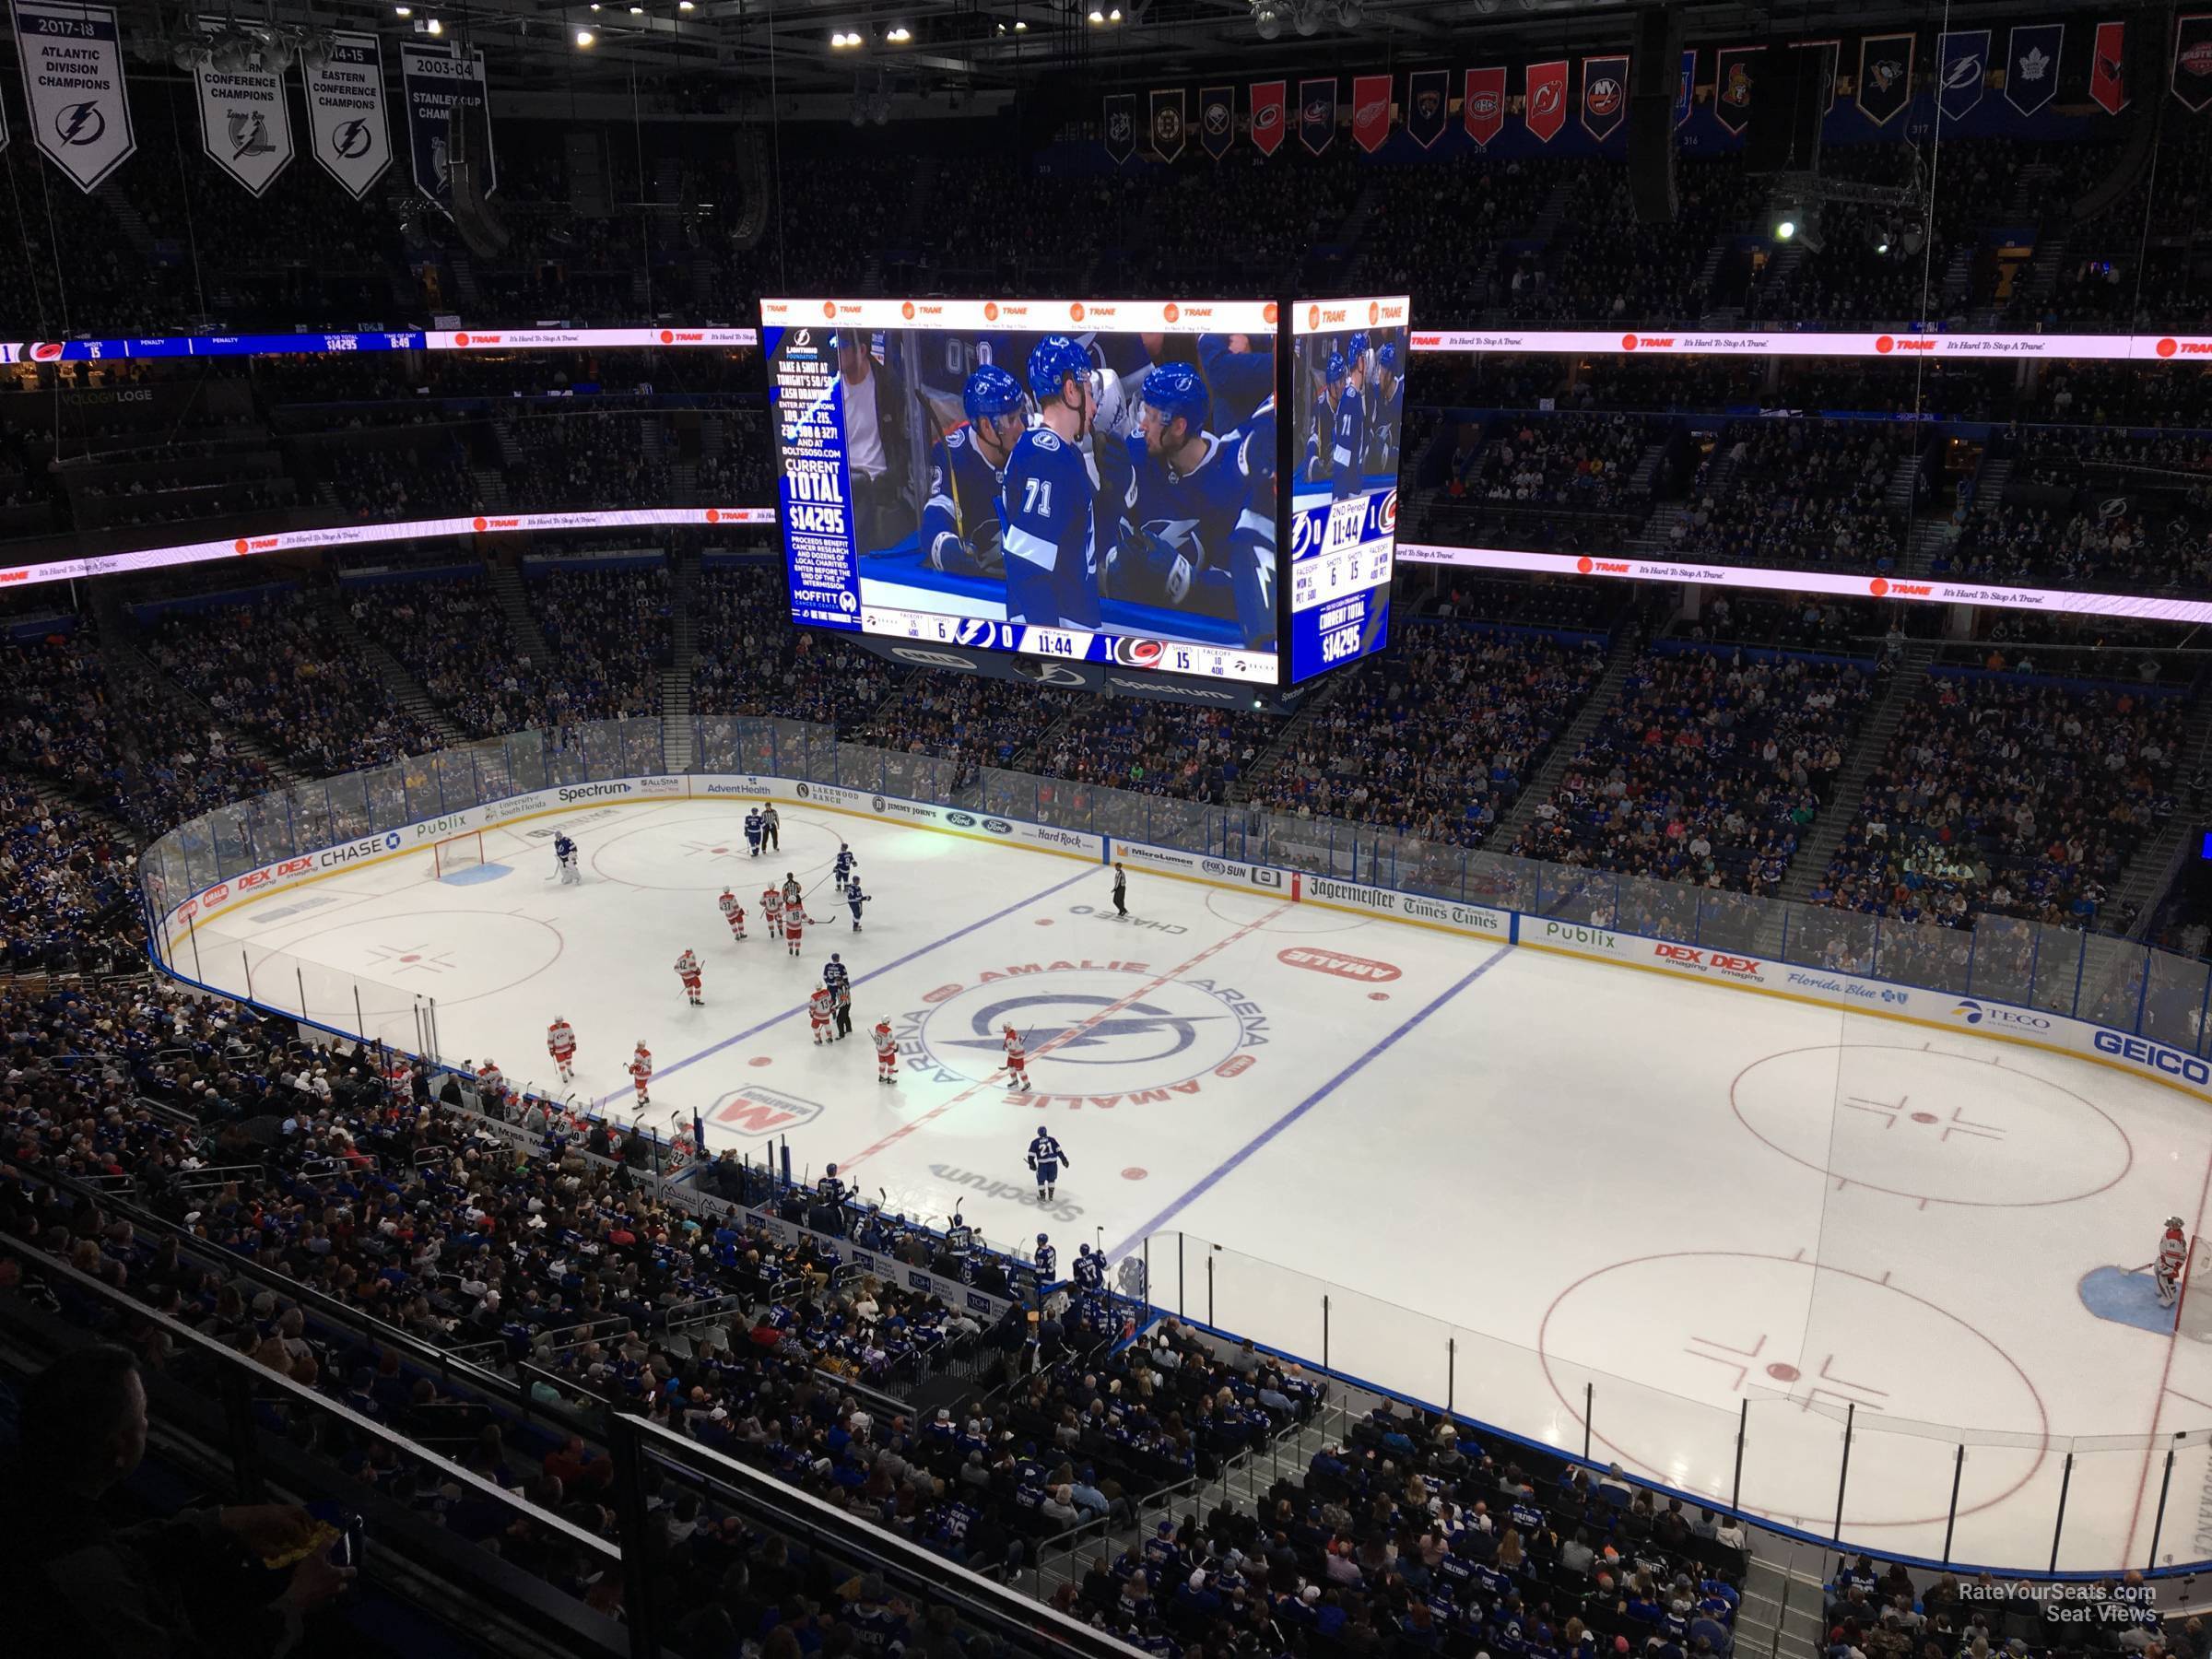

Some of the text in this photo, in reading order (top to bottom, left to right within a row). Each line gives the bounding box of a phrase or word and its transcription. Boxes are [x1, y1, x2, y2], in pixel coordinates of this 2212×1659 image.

[41, 47, 100, 60] ATLANTIC
[46, 62, 98, 75] DIVISION
[418, 60, 472, 76] 2003-04
[38, 76, 110, 90] CHAMPIONS
[205, 73, 276, 88] CONFERENCE
[322, 71, 365, 82] EASTERN
[211, 88, 274, 101] CHAMPIONS
[313, 83, 376, 97] CONFERENCE
[319, 97, 375, 110] CHAMPIONS
[413, 93, 457, 106] STANLEY
[919, 306, 942, 314] TRANE
[1003, 307, 1027, 315] TRANE
[1089, 308, 1116, 316] TRANE
[1184, 308, 1213, 317] TRANE
[1323, 310, 1347, 324] TRANE
[1382, 307, 1403, 318] TRANE
[327, 339, 357, 350] $14295
[392, 338, 409, 347] 8:49
[1411, 336, 1441, 346] TRANE
[1640, 338, 1675, 347] TRANE
[1897, 340, 1937, 350] TRANE
[1947, 341, 1959, 349] It's
[1959, 341, 1981, 350] Hard
[1982, 342, 1991, 350] To
[1993, 341, 2010, 352] Stop
[2011, 342, 2019, 350] A
[91, 347, 100, 358] 15
[779, 361, 828, 373] TAKE A SHOT AT
[777, 374, 810, 386] TONIGHT'S
[782, 447, 841, 458] BOLTS5050.COM
[785, 459, 840, 474] CURRENT
[787, 471, 843, 503] TOTAL
[1023, 478, 1052, 517] 71
[1347, 501, 1366, 514] Period
[489, 519, 519, 528] TRANE
[790, 505, 845, 534] $14295
[1370, 505, 1375, 529] 1
[1313, 519, 1321, 545] 0
[1333, 515, 1359, 546] 11:44
[250, 538, 278, 549] TRANE
[792, 536, 849, 547] PROCEEDS BENEFIT
[792, 543, 849, 554] CANCER RESEARCH
[811, 552, 835, 560] DOZENS
[1326, 557, 1342, 568] SHOTS
[815, 567, 838, 575] BEFORE
[1296, 564, 1318, 576] FACEOFF
[1350, 561, 1359, 581] 15
[1595, 562, 1630, 573] TRANE
[1331, 568, 1336, 586] 6
[802, 579, 845, 590] INTERMISSION
[1891, 583, 1933, 595] TRANE
[794, 590, 838, 604] MOFFITT
[818, 602, 839, 610] CENTER
[1320, 601, 1365, 630] CURRENT TOTAL
[938, 623, 945, 639] 6
[1002, 625, 1013, 648] 0
[1039, 634, 1072, 656] 11:44
[1104, 637, 1113, 661] 1
[1323, 624, 1360, 663] $14295
[1177, 652, 1190, 669] 15
[1110, 677, 1235, 700] Spectrum
[559, 782, 628, 803] Spectrum
[708, 783, 771, 795] AdventHealth
[813, 786, 859, 800] LAKEWOOD
[499, 796, 534, 810] University
[813, 794, 841, 805] RANCH
[500, 801, 546, 818] South Florida
[888, 803, 936, 818] JIMMY JOHN'S
[951, 814, 971, 826] Ford
[987, 820, 1007, 833] Ford
[1038, 829, 1059, 842] Hard
[1061, 832, 1081, 849] Rock
[321, 838, 382, 867] CHASE
[1132, 848, 1194, 865] MicroLumen
[277, 856, 313, 877] DEX
[287, 866, 318, 879] imaging
[1206, 862, 1220, 870] FOX
[1227, 865, 1246, 878] SUN
[238, 868, 271, 890] DEX
[246, 879, 276, 893] imaging
[1403, 897, 1447, 920] Times
[1093, 910, 1188, 935] CHASE
[1453, 907, 1498, 930] Times
[1654, 943, 1704, 964] DEX
[980, 959, 1150, 983] AMALIE
[1286, 949, 1394, 981] AMALIE
[1665, 958, 1708, 972] imaging
[1710, 954, 1762, 974] DEX
[1722, 969, 1764, 982] imaging
[1787, 972, 1877, 999] Florida Blue
[1184, 978, 1270, 1048] ARENA
[1986, 1008, 2051, 1030] TECO
[895, 1008, 965, 1084] ARENA
[2094, 1030, 2210, 1086] GEICO
[1002, 1078, 1202, 1111] AMALIE
[741, 1090, 813, 1114] MARATHON
[1038, 1141, 1053, 1157] 21
[1082, 1265, 1097, 1281] 17
[912, 1275, 930, 1288] TGH
[970, 1295, 989, 1309] TGH
